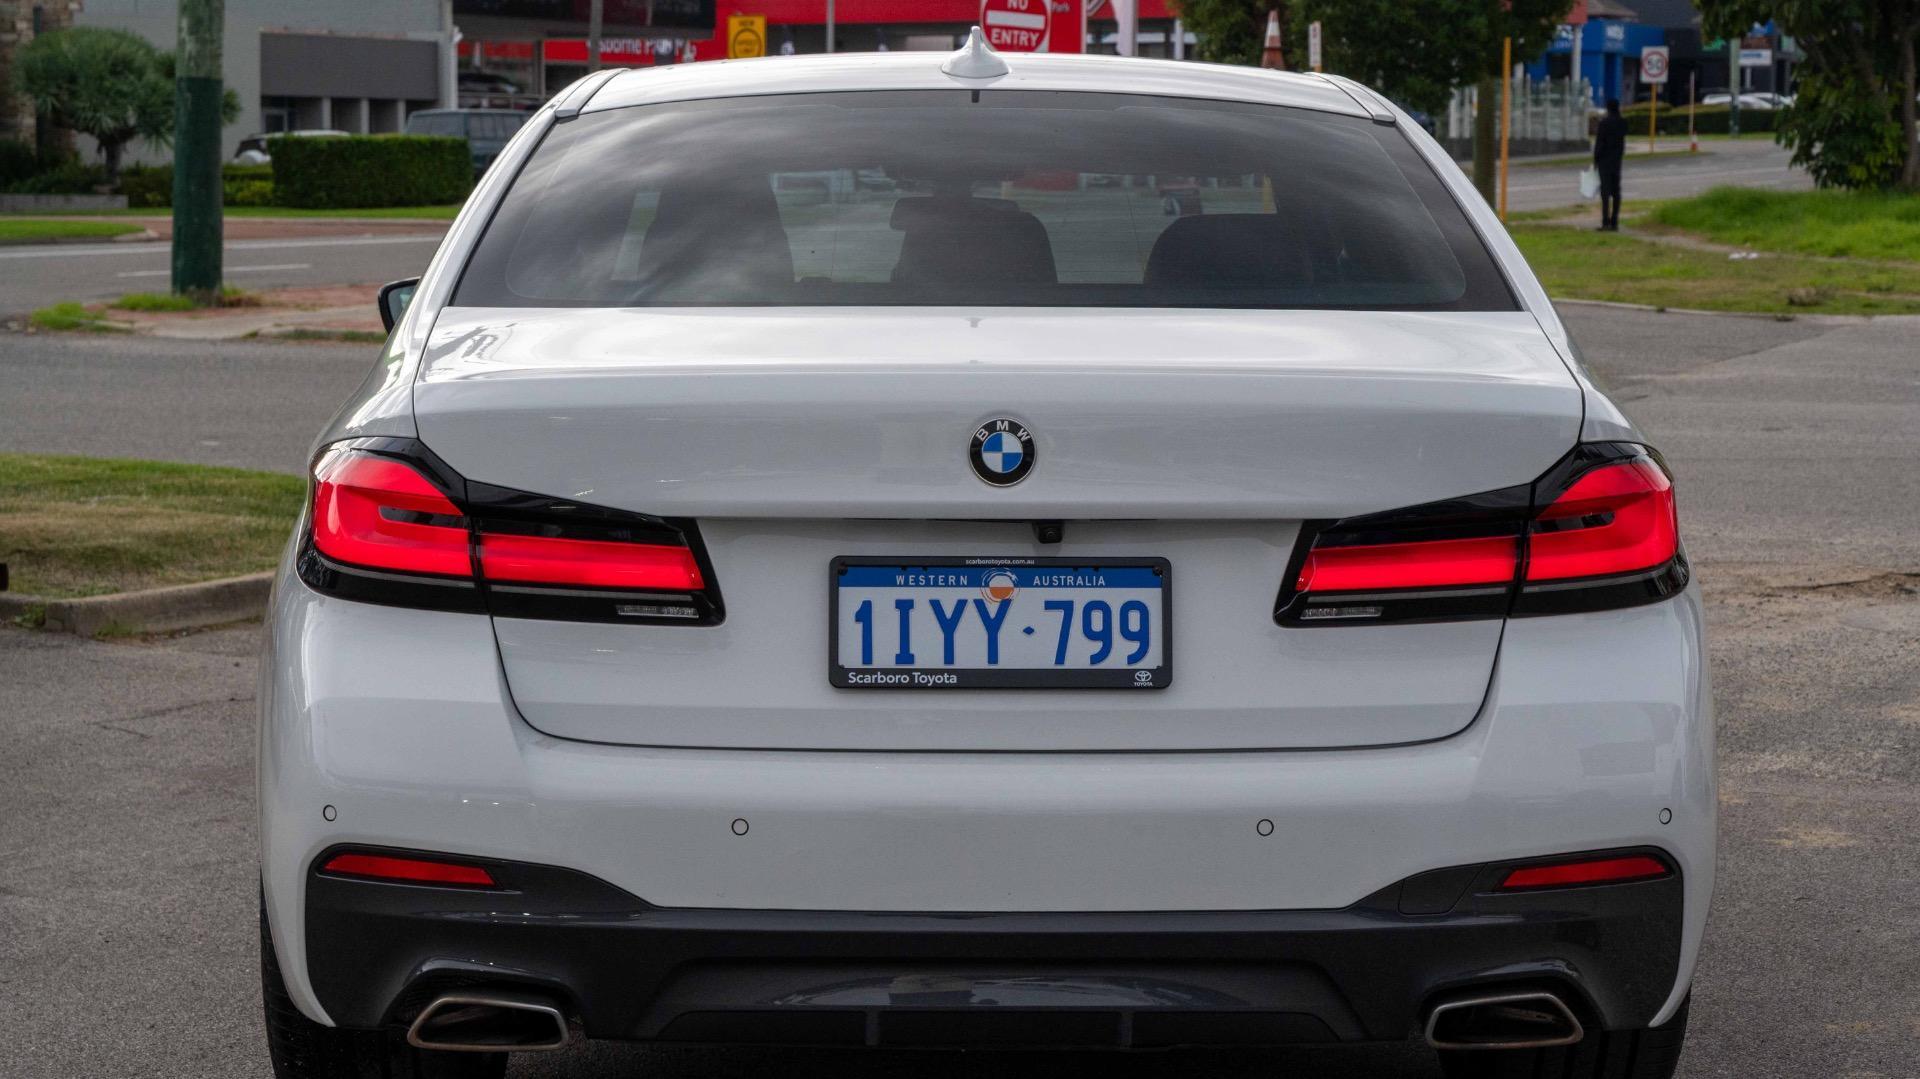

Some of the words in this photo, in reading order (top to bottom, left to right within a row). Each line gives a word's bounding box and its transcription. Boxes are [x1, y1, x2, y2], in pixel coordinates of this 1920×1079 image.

[991, 28, 1040, 47] ENTRY
[976, 420, 1031, 442] BMW
[965, 558, 1035, 566] scarborotoyota.com.au
[896, 575, 968, 586] WESTERN
[1033, 576, 1106, 586] AUSTRALIA
[848, 672, 909, 685] Scarboro
[911, 672, 958, 687] Toyota
